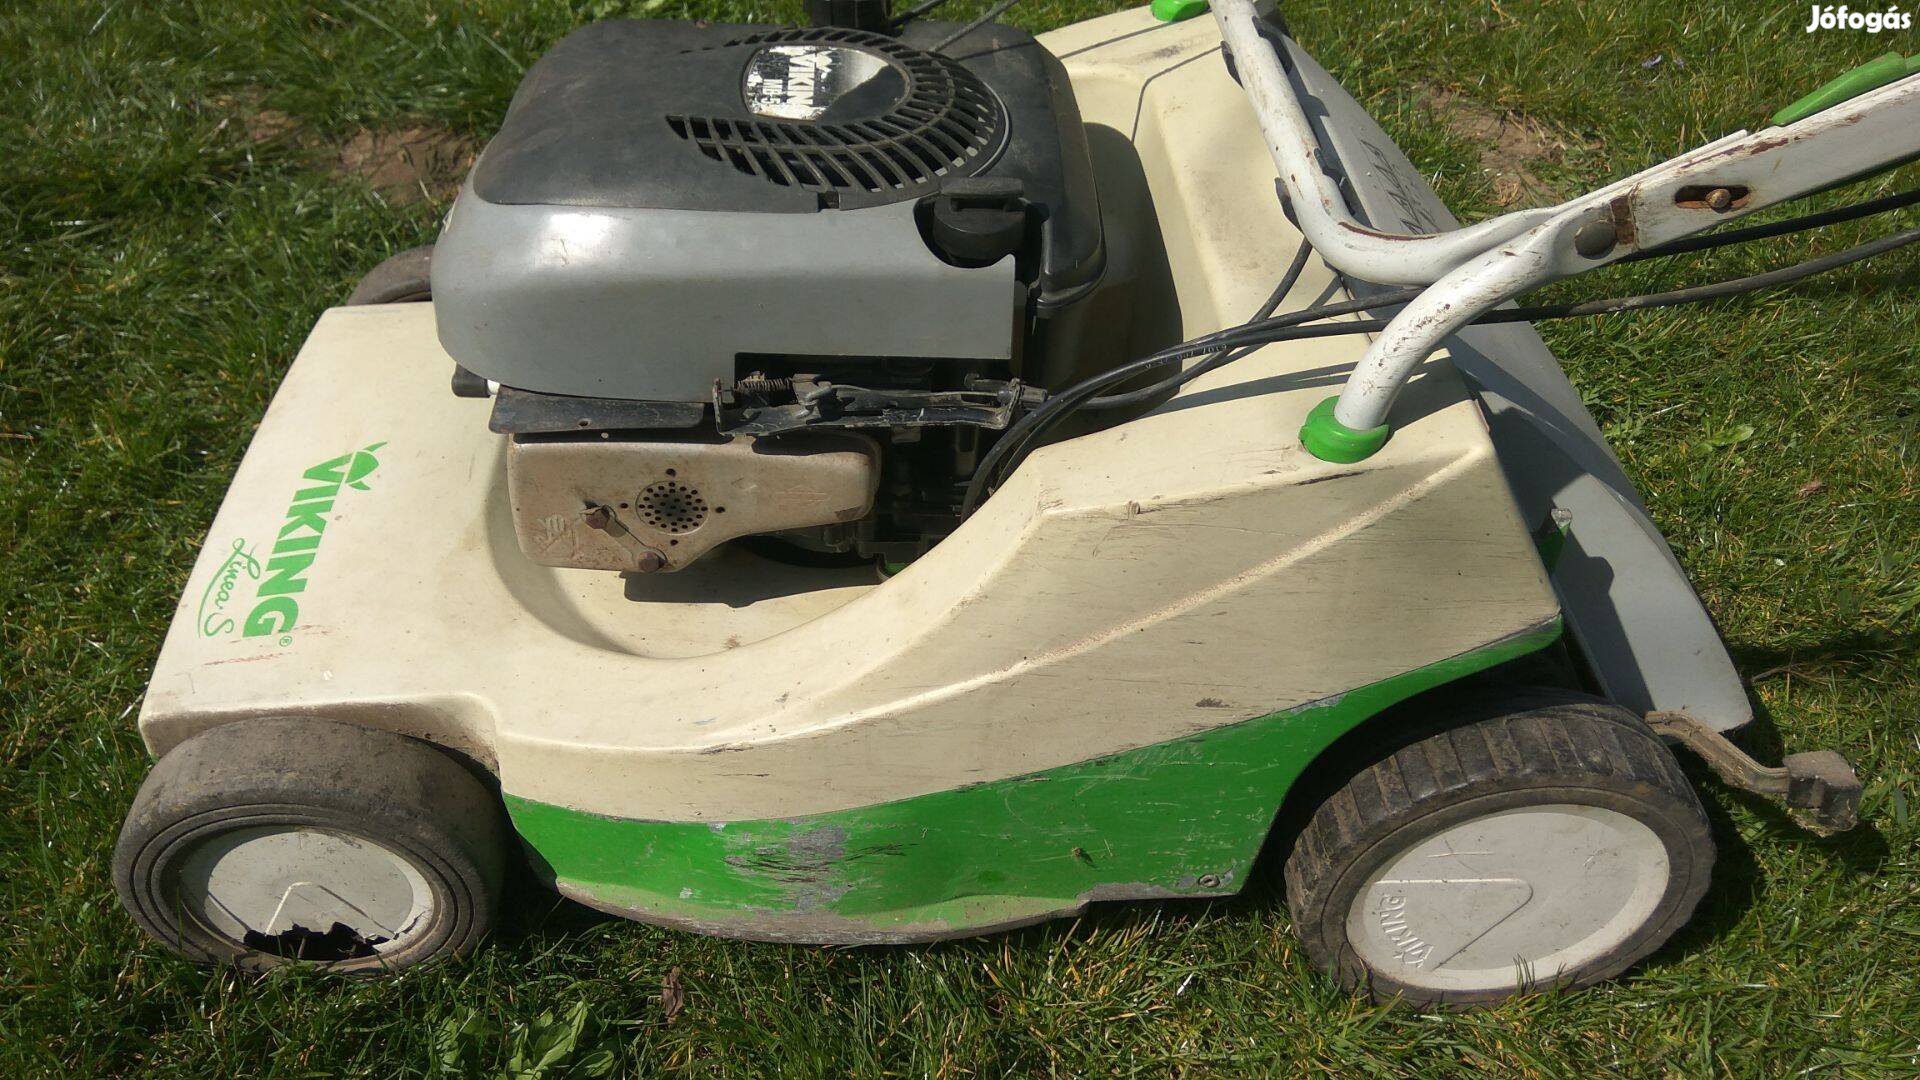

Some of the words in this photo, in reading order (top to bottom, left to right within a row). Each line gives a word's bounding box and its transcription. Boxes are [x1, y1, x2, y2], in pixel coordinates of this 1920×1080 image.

[786, 53, 815, 115] VIKIN
[205, 536, 262, 612] Linea
[203, 611, 235, 637] S
[1380, 893, 1434, 965] VIKING
